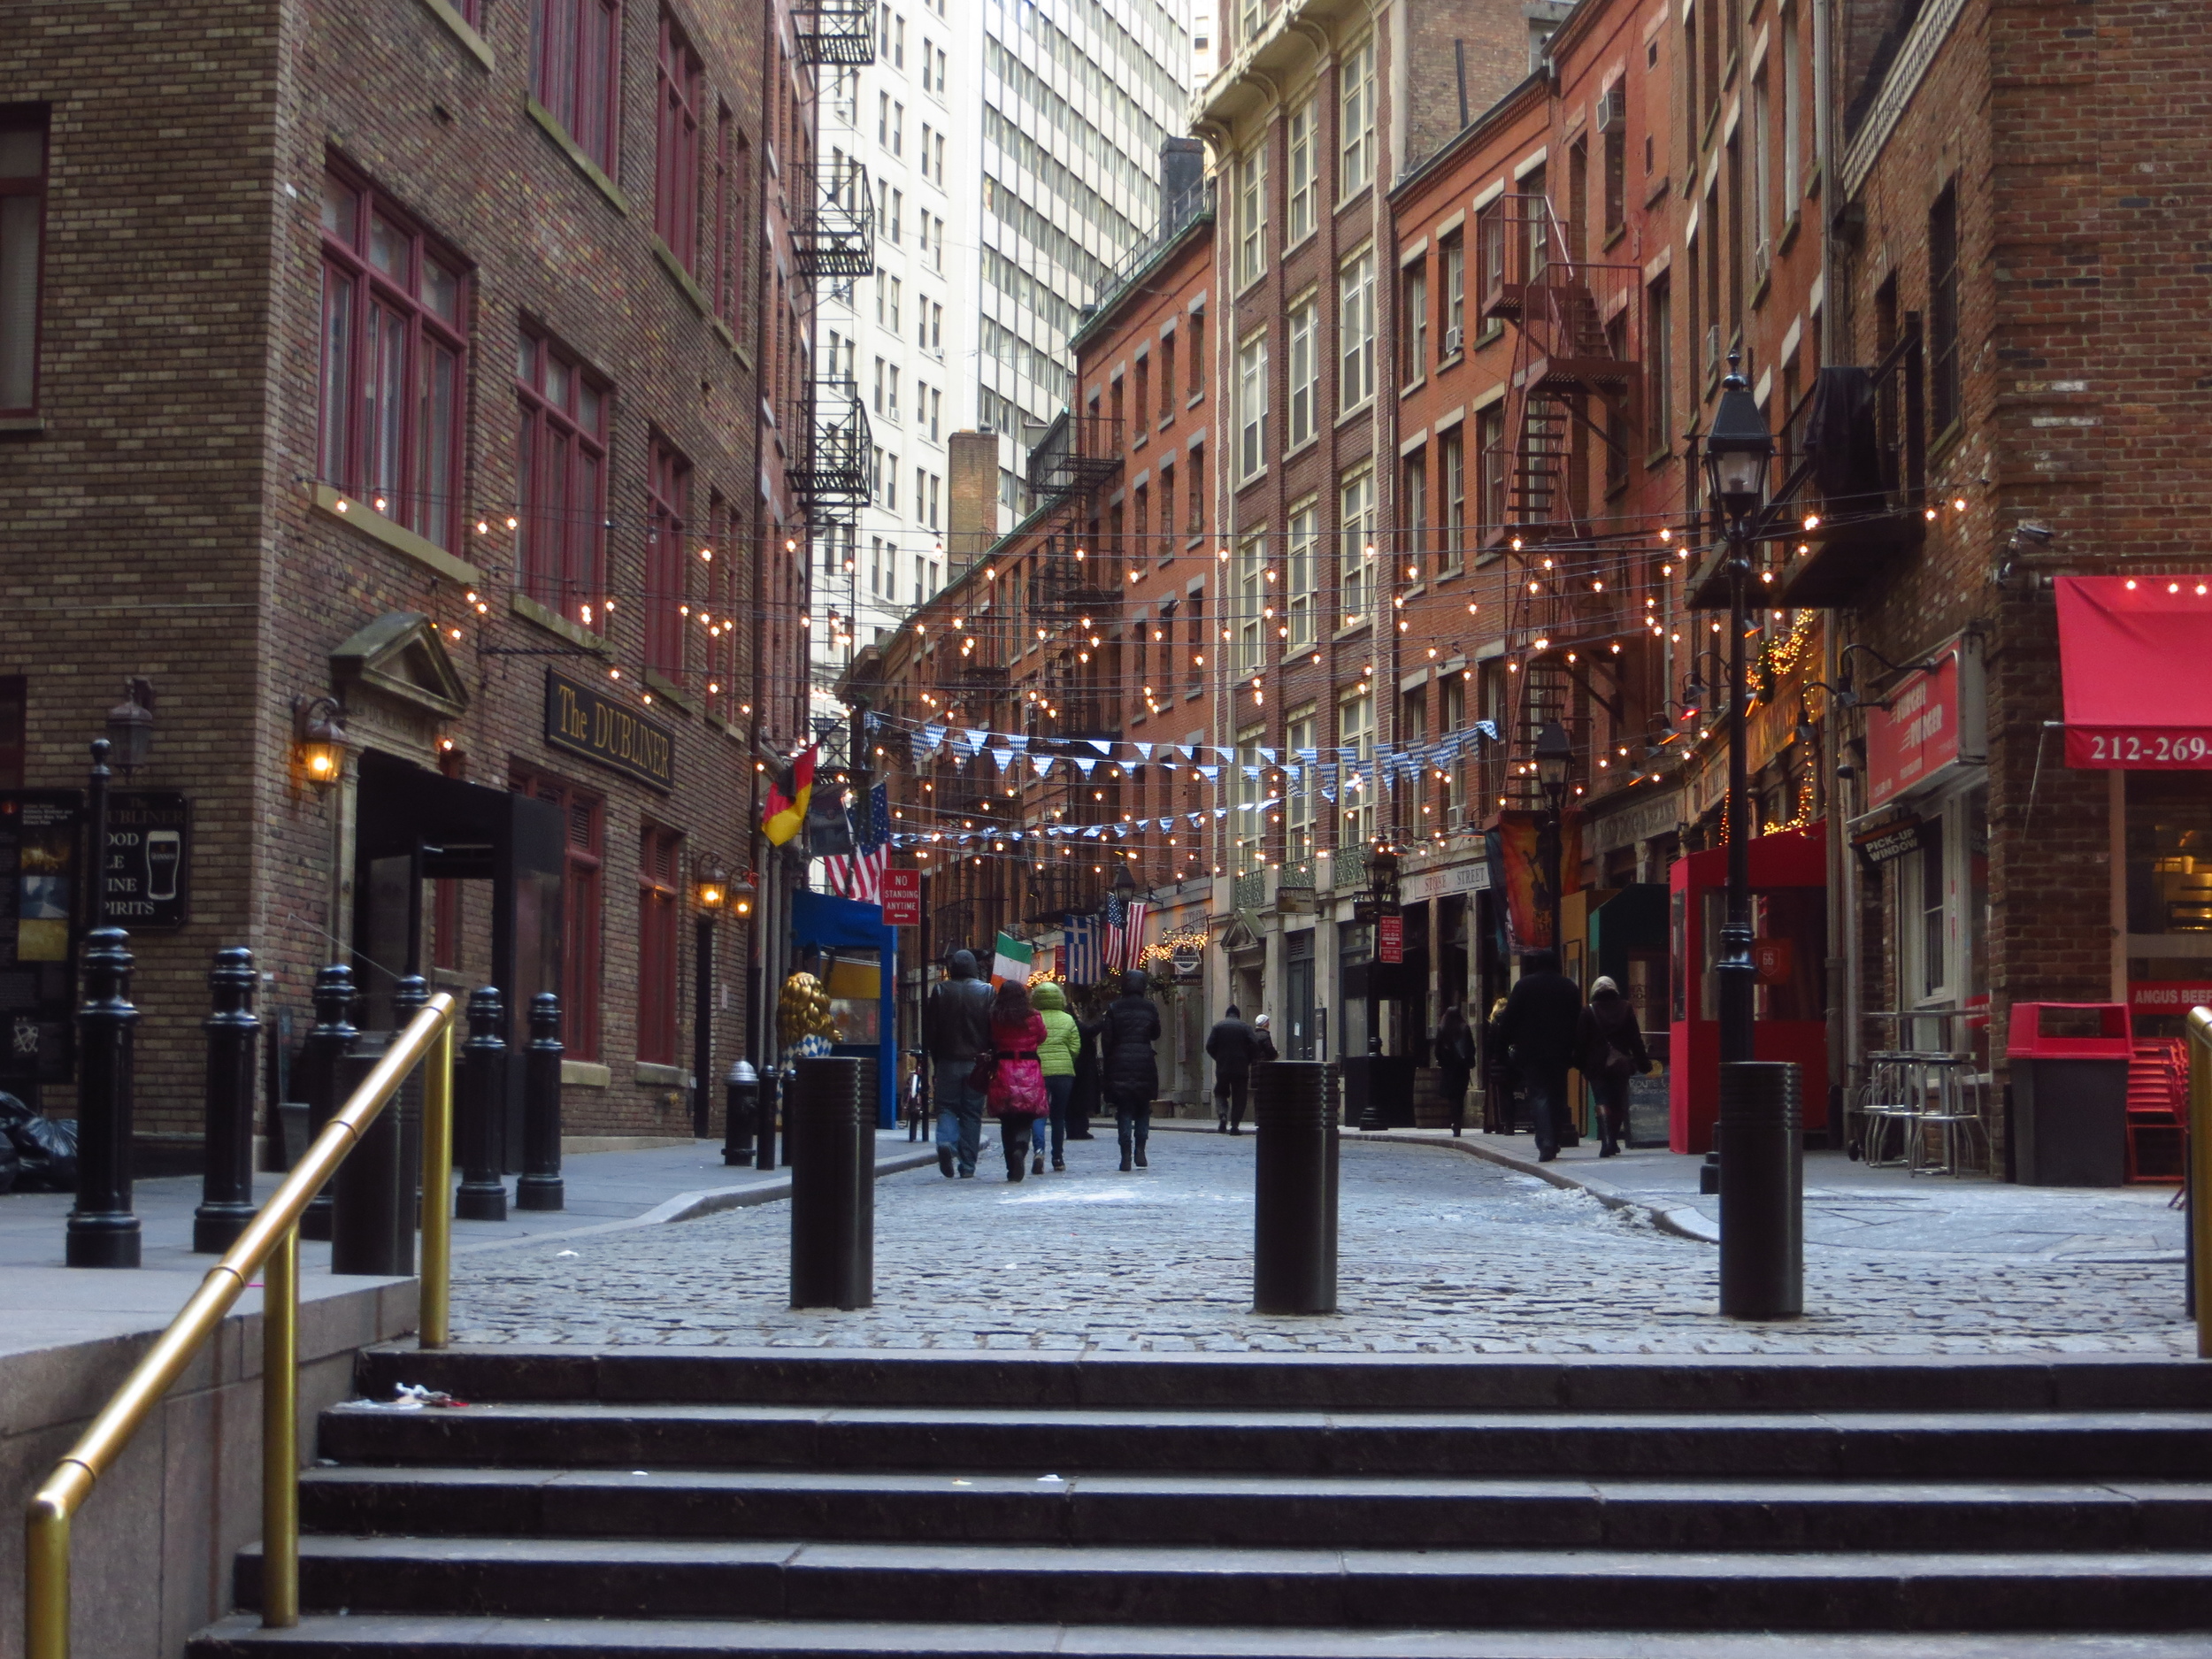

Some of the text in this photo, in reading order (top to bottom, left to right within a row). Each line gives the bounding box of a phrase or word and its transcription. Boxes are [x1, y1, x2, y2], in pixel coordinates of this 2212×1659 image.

[558, 684, 670, 780] The DUBLINER
[106, 810, 184, 824] UBLINER
[107, 833, 140, 846] OOD
[1865, 828, 1915, 853] PICK-UP
[1869, 838, 1918, 862] WINDOW
[107, 878, 137, 892] INE
[895, 875, 908, 886] NO
[1425, 867, 1485, 892] STONE STREET
[885, 889, 918, 899] STANDING
[887, 902, 916, 910] ANYTIME
[2135, 989, 2212, 1004] ANGUS BEEF
